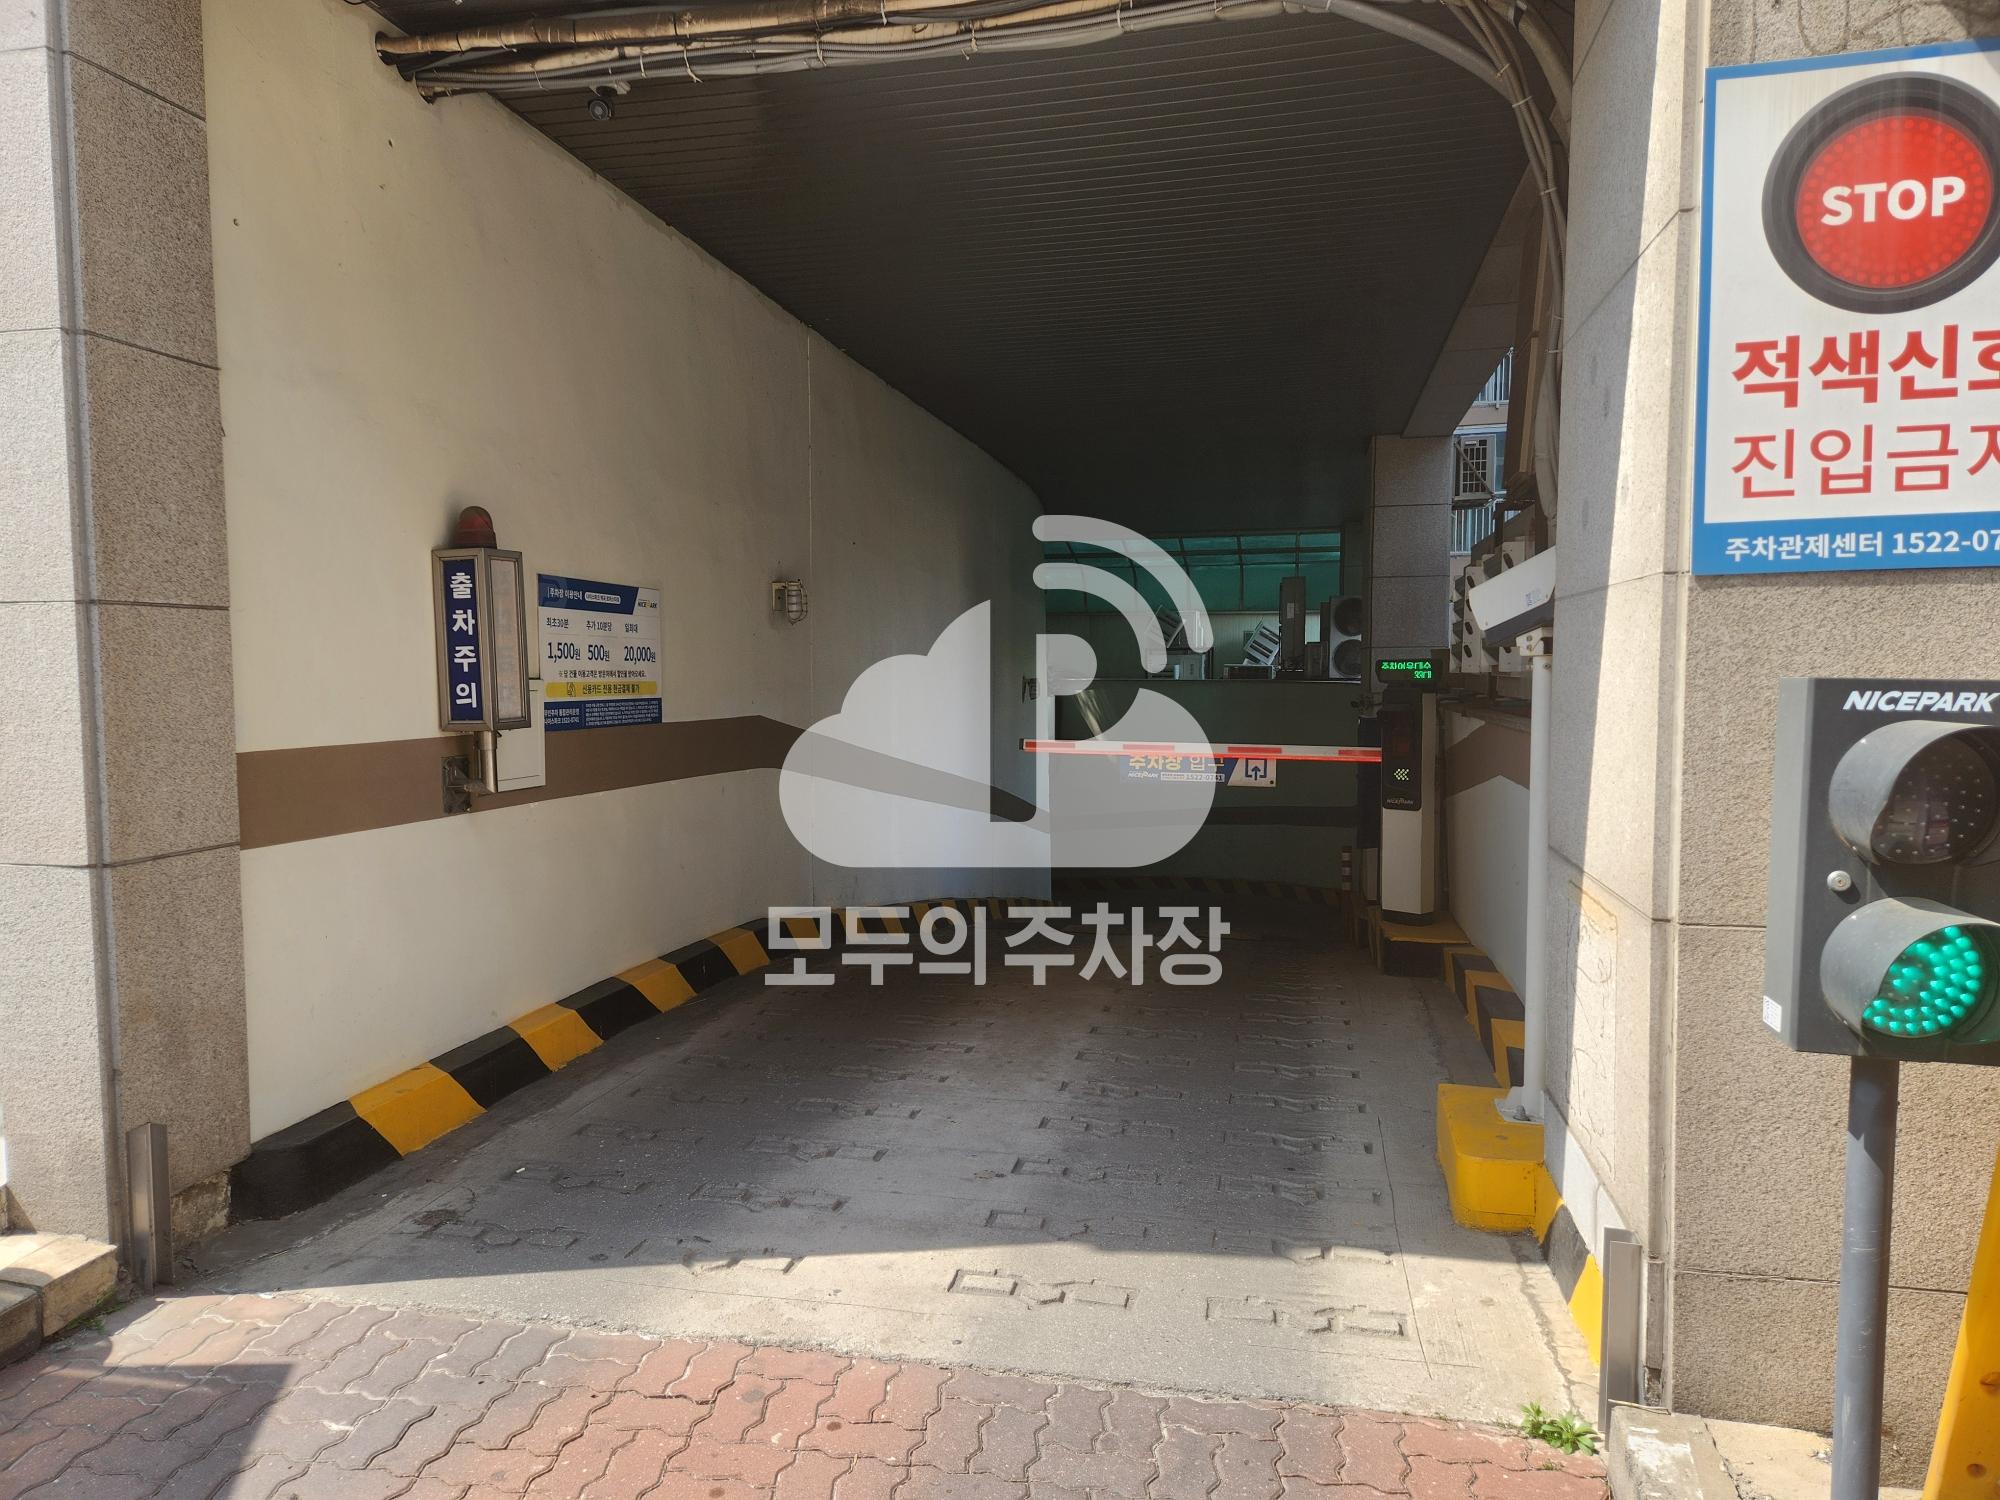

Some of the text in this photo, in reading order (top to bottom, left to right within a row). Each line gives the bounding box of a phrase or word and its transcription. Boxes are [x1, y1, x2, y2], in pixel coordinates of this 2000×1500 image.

[1820, 175, 1967, 226] STOP
[1725, 531, 1883, 562] 주차관제센터
[450, 572, 478, 709] 출차주의
[1842, 690, 2000, 712] NICEPARK
